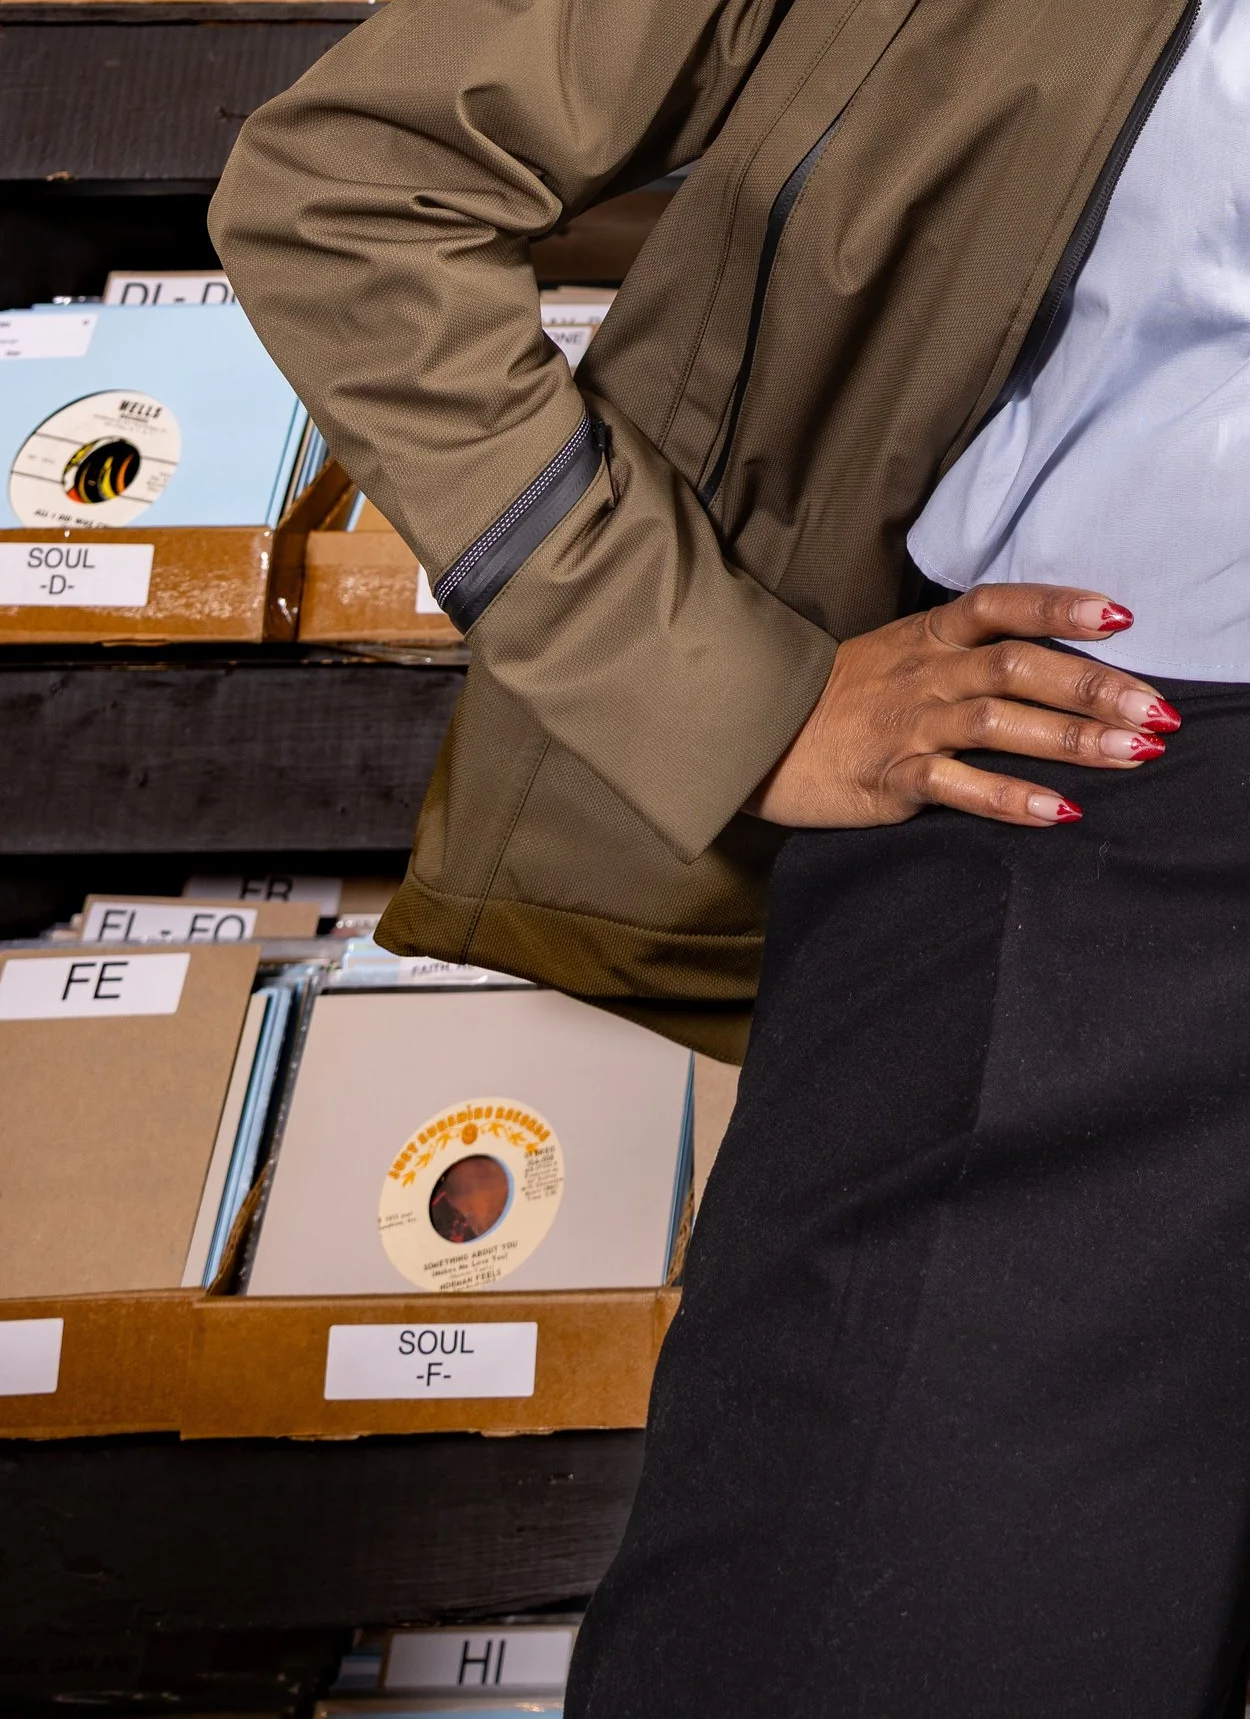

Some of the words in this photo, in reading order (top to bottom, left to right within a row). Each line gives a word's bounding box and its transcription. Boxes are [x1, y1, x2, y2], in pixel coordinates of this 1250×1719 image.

[118, 399, 164, 420] WELLS
[26, 545, 96, 569] SOUL
[38, 572, 76, 596] -D-
[187, 913, 247, 943] FO
[62, 961, 130, 1000] FE
[423, 1253, 469, 1272] SOMETHING
[471, 1245, 498, 1260] ABOUT
[501, 1240, 519, 1253] YOU
[397, 1329, 475, 1357] SOUL
[415, 1361, 452, 1388] -F-
[457, 1639, 506, 1685] HI
